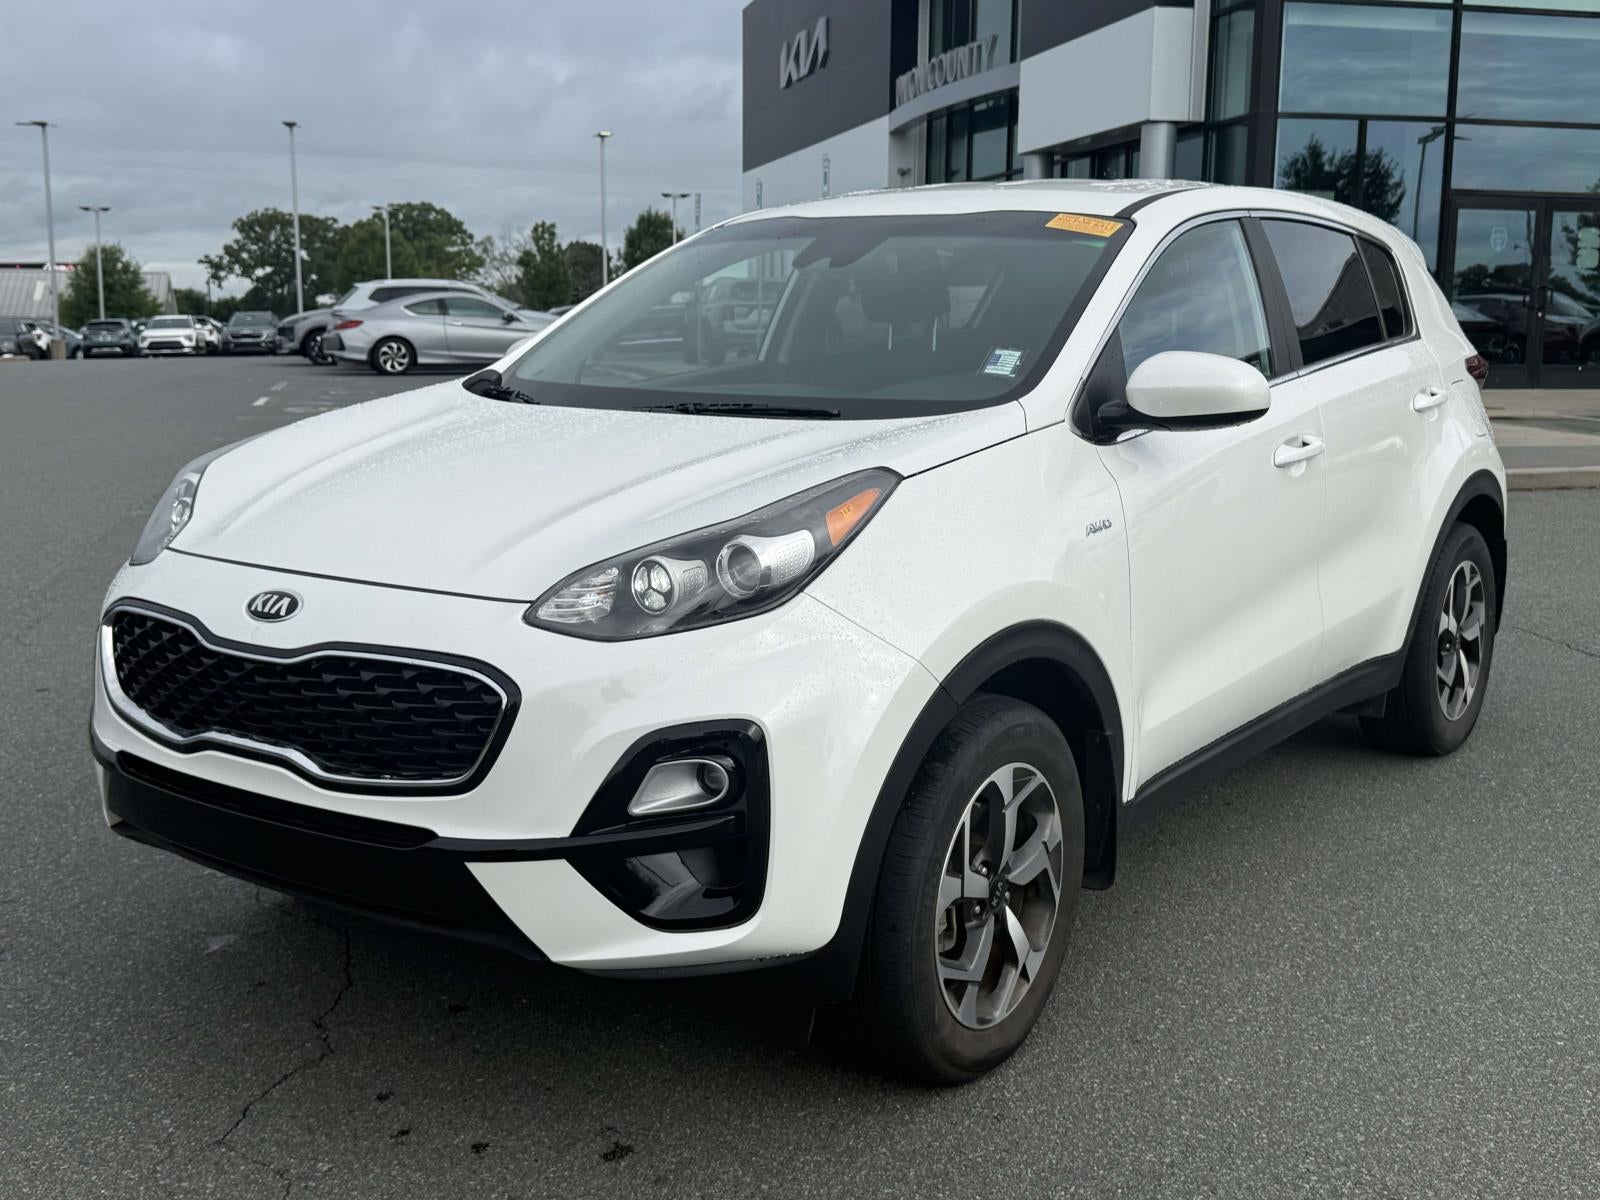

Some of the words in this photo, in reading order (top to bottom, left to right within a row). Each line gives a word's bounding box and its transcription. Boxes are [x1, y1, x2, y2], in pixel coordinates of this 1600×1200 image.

[779, 16, 829, 89] KIA
[928, 34, 999, 90] COUNTY
[1086, 519, 1112, 537] AWD
[250, 593, 291, 616] KIA
